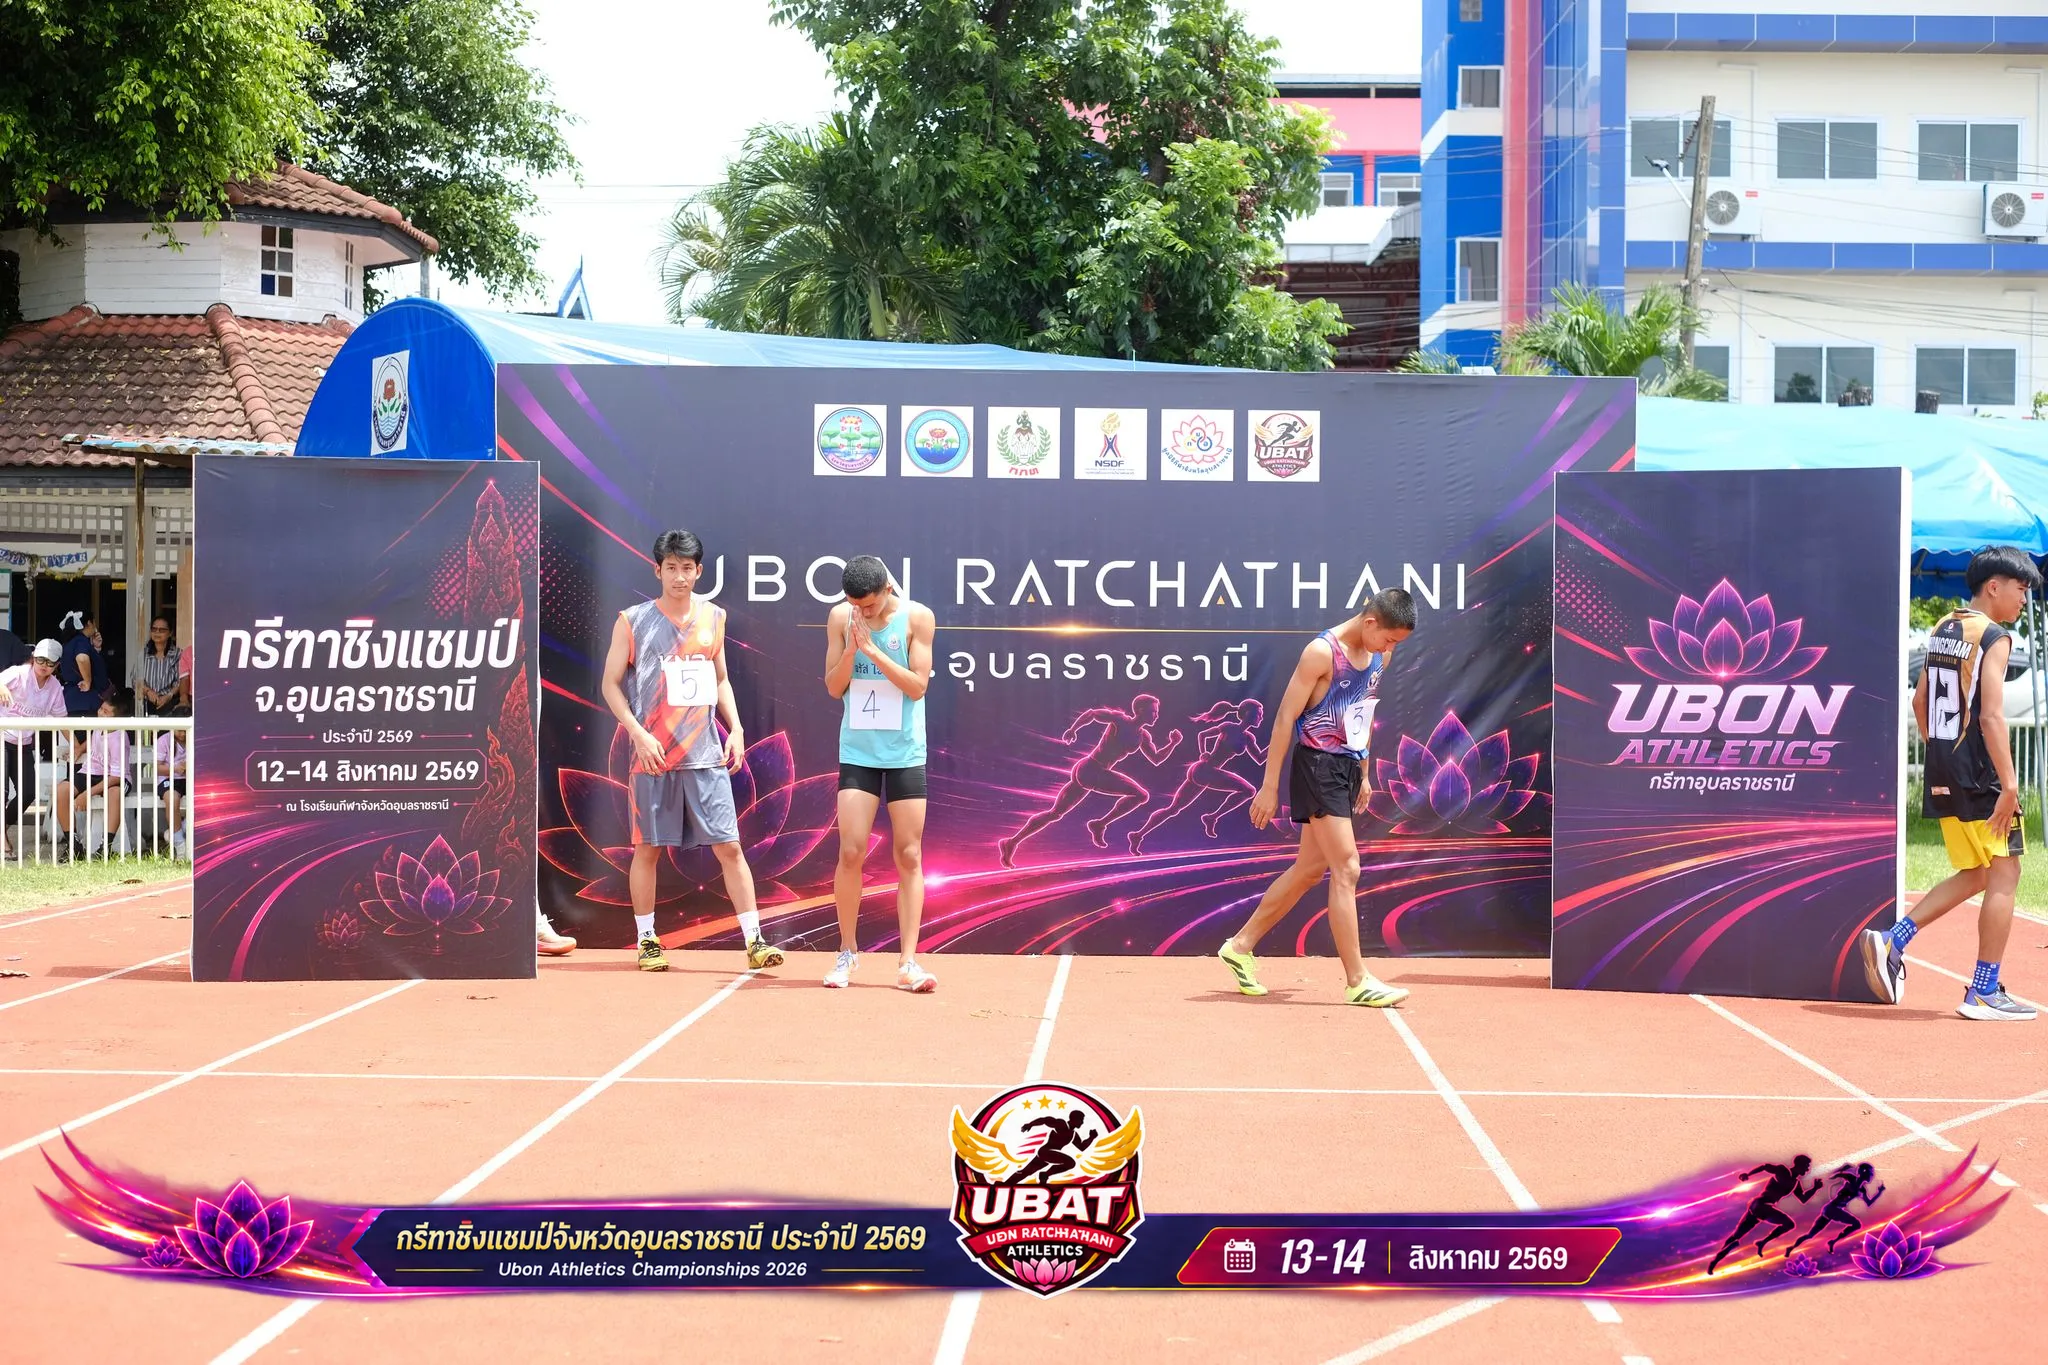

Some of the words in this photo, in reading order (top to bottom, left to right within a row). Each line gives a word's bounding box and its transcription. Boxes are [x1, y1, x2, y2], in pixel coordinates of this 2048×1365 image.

[1259, 446, 1309, 460] UBAT
[956, 558, 1465, 610] RATCHATHANI
[218, 616, 521, 669] กรีฑาชิงแชมป์
[928, 643, 1249, 692] .อุบลราชธานี
[681, 669, 699, 700] 5
[255, 675, 477, 723] จ.อุบลราชธานี
[862, 690, 880, 718] 4
[1607, 684, 1856, 735] UBON
[1928, 667, 1960, 741] 12
[1353, 707, 1364, 735] 3
[323, 729, 373, 743] ประจำปี
[377, 730, 413, 743] 2569
[1612, 739, 1846, 766] ATHLETICS
[336, 759, 417, 782] สิงหาคม
[425, 761, 479, 781] 2569
[1649, 772, 1796, 795] กรีฑาอุบลราชธานี
[286, 802, 297, 812] ณ
[300, 799, 449, 814] โรงเรียนกีฬาจังหวัดอุบลราชธานี
